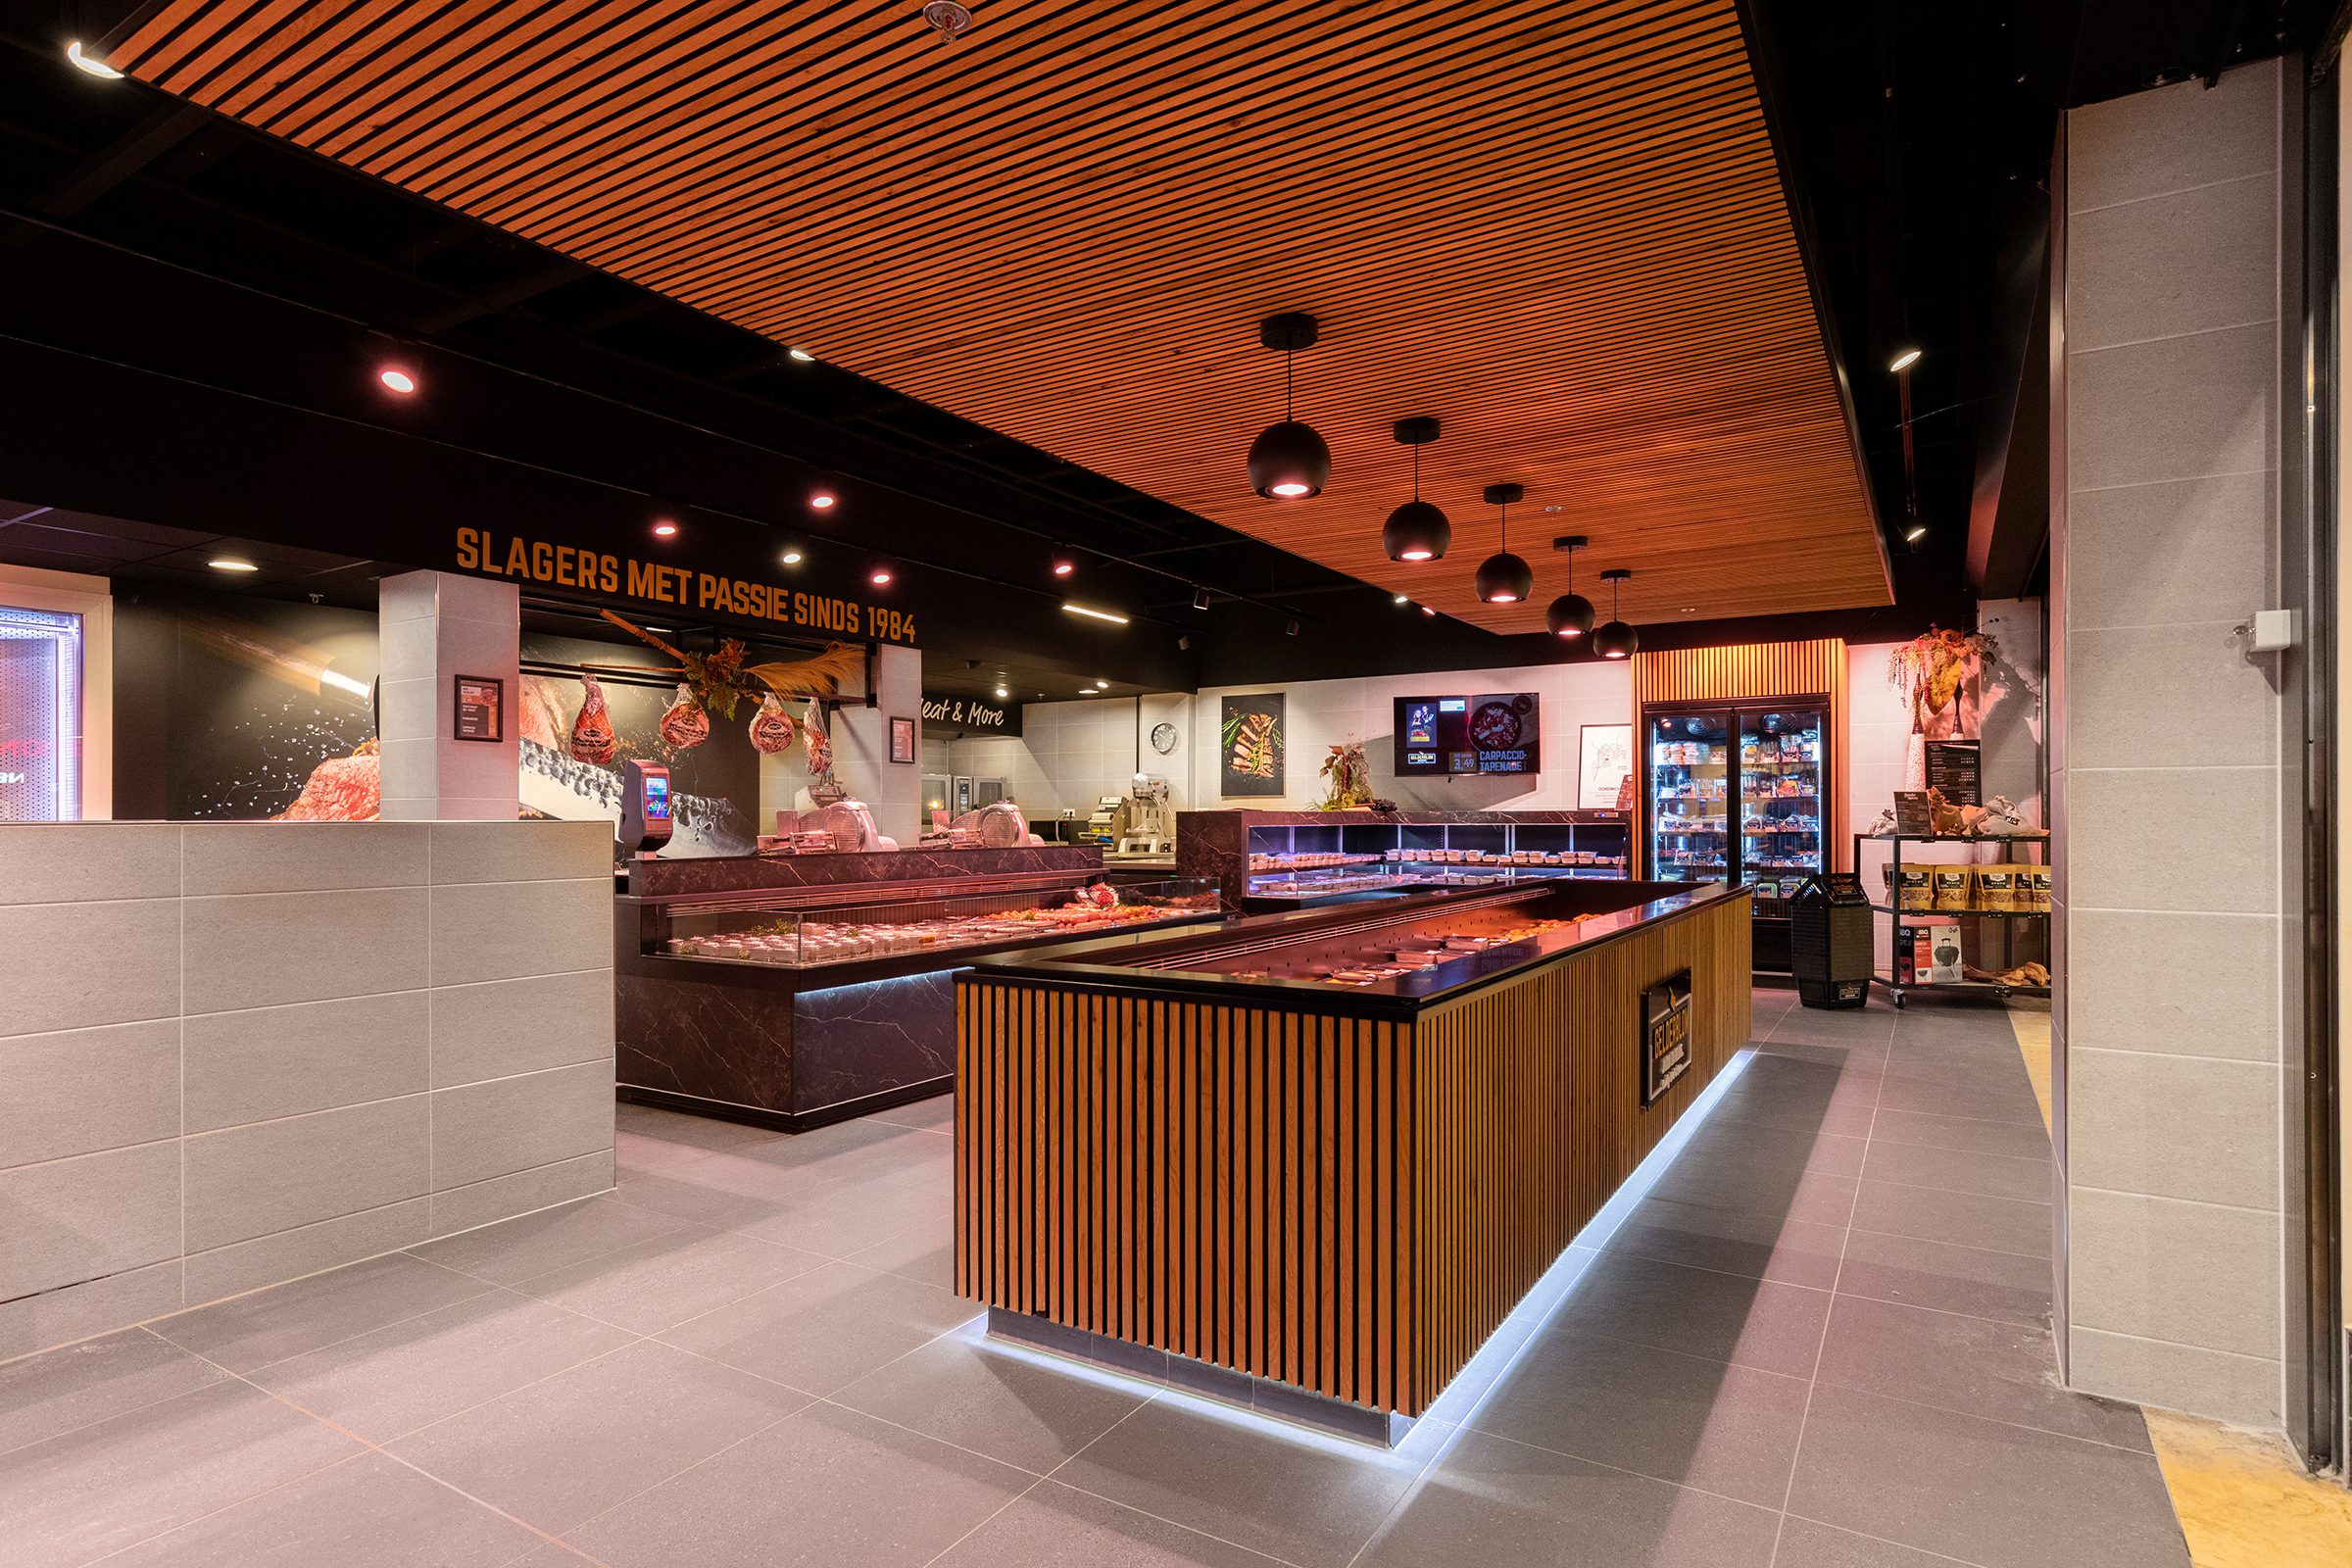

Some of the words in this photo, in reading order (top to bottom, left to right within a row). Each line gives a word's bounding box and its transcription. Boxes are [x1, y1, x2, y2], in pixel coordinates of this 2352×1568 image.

[457, 526, 618, 593] SLAGERS
[627, 559, 692, 605] MET
[699, 572, 789, 622] PASSIE
[794, 592, 859, 633] SINDS
[867, 606, 915, 643] 1984
[921, 698, 951, 720] eat
[952, 701, 962, 722] &
[967, 702, 1004, 726] More
[1453, 758, 1475, 771] 3,49
[1479, 760, 1522, 771] TAPENADE
